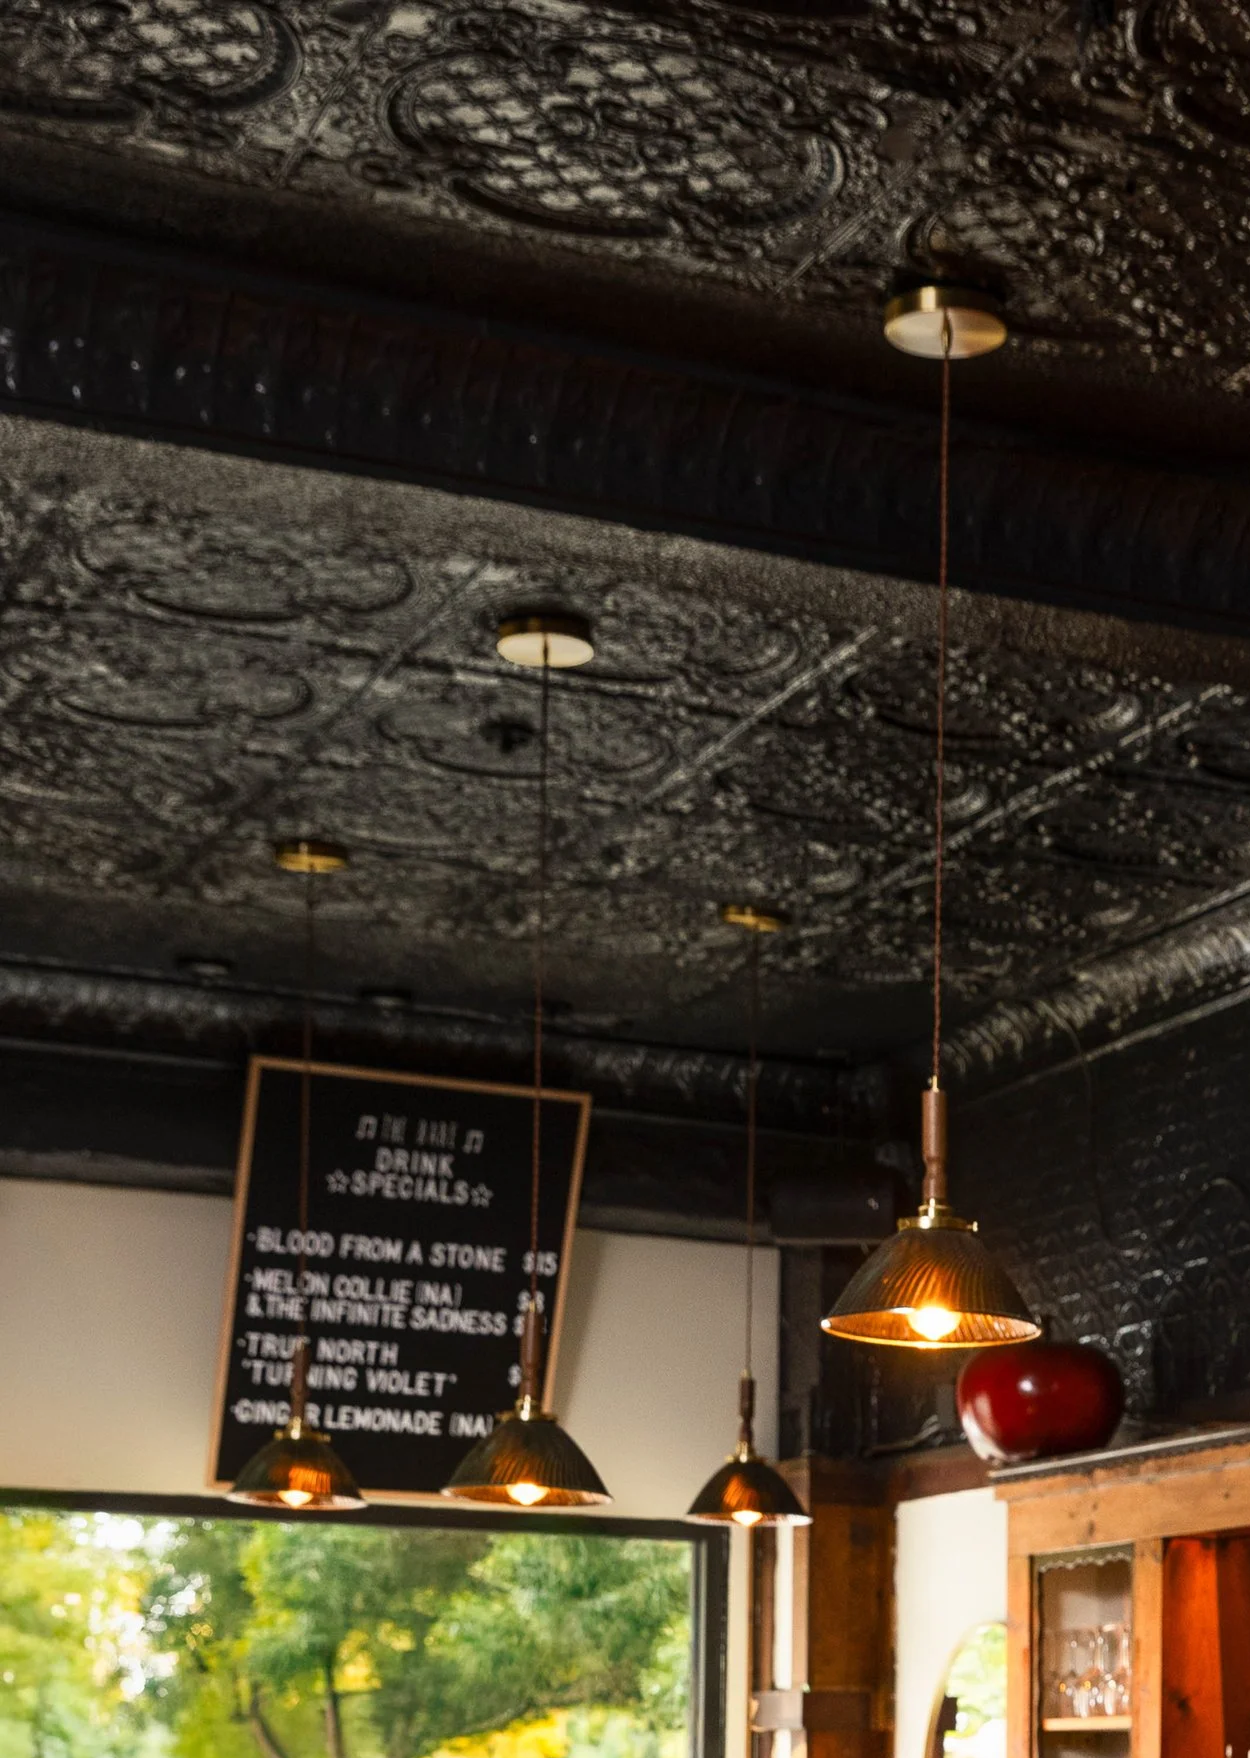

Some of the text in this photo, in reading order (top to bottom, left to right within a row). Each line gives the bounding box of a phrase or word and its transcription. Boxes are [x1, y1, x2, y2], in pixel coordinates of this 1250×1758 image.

[375, 1146, 455, 1179] DRINK
[350, 1168, 470, 1205] SPECIALS
[256, 1225, 335, 1258] BLOOD
[339, 1232, 403, 1264] FROM
[405, 1239, 423, 1266] A
[429, 1241, 507, 1273] STONE
[333, 1273, 414, 1305] COLLIE
[310, 1297, 407, 1329] INFINITE
[409, 1305, 508, 1337] SADNESS
[246, 1331, 399, 1367] TRU NORTH
[234, 1397, 320, 1428] GINGR
[323, 1402, 444, 1436] LEMONADE
